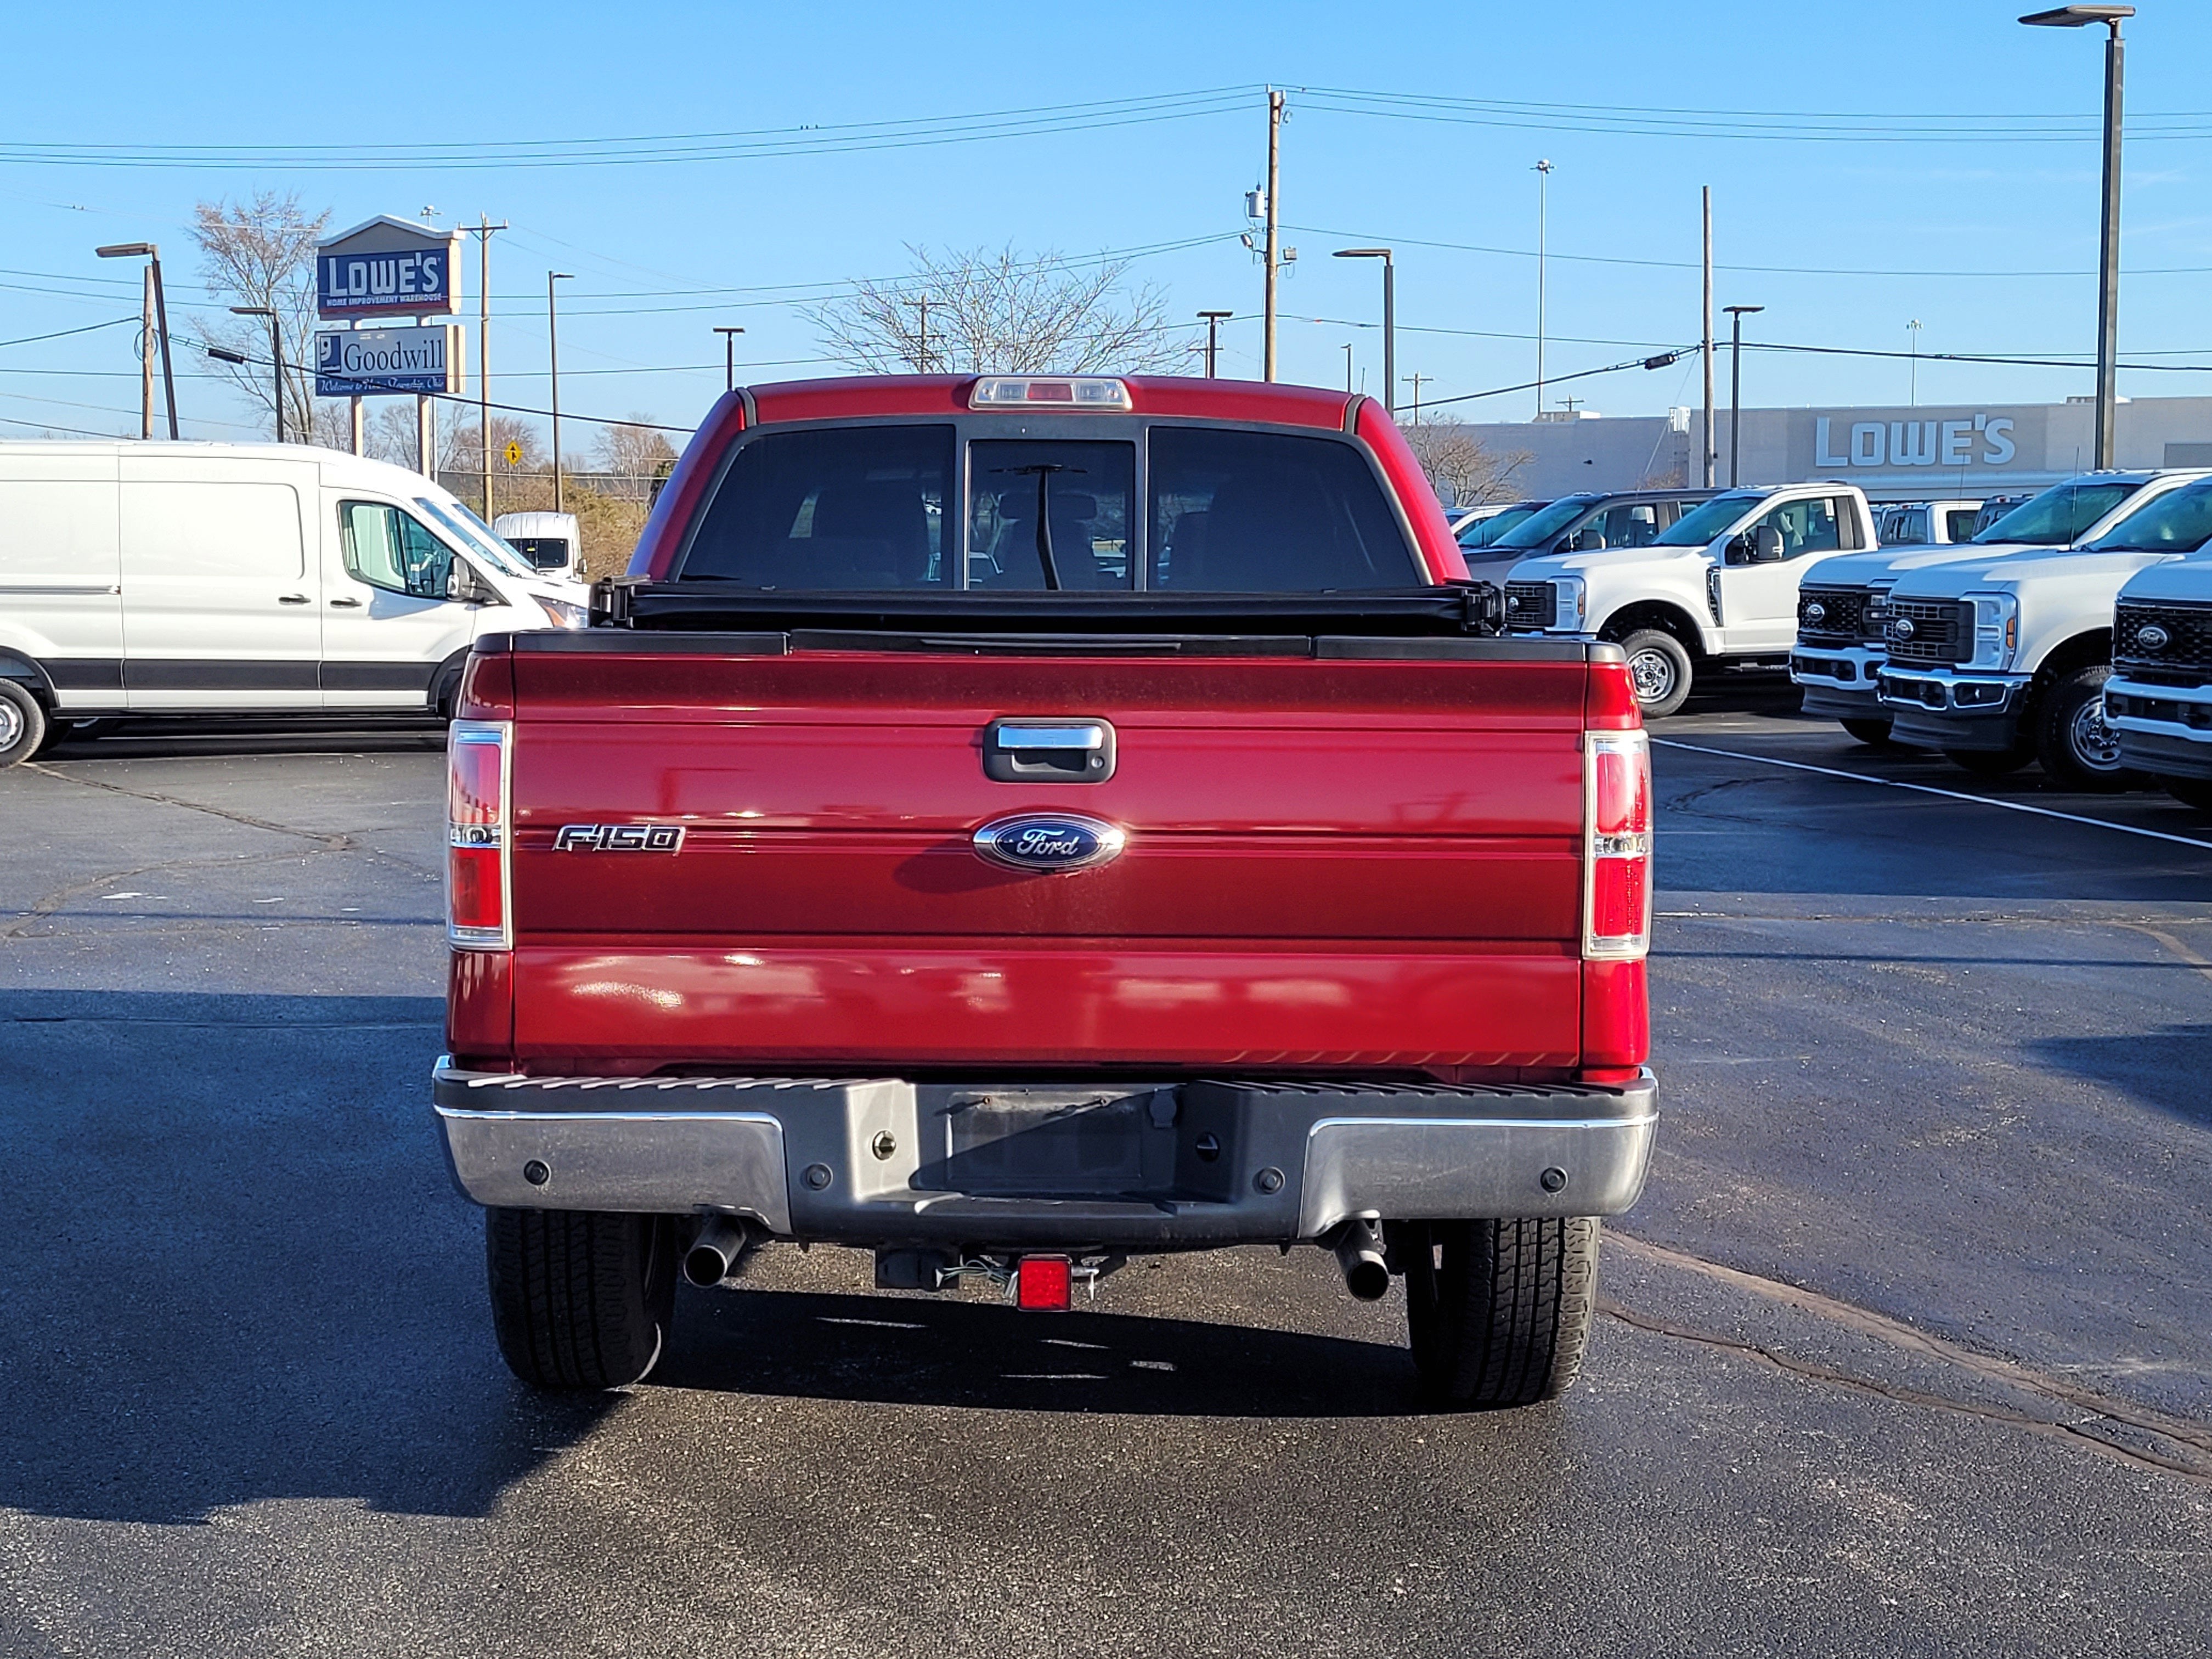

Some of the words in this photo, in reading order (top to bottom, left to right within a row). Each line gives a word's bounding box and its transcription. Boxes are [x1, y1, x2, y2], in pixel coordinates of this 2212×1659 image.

[329, 252, 439, 297] LOWE'S
[344, 339, 444, 372] Goodwill
[1815, 414, 2016, 466] LOWE'S
[552, 823, 686, 856] F-150
[1016, 828, 1080, 855] Ford
